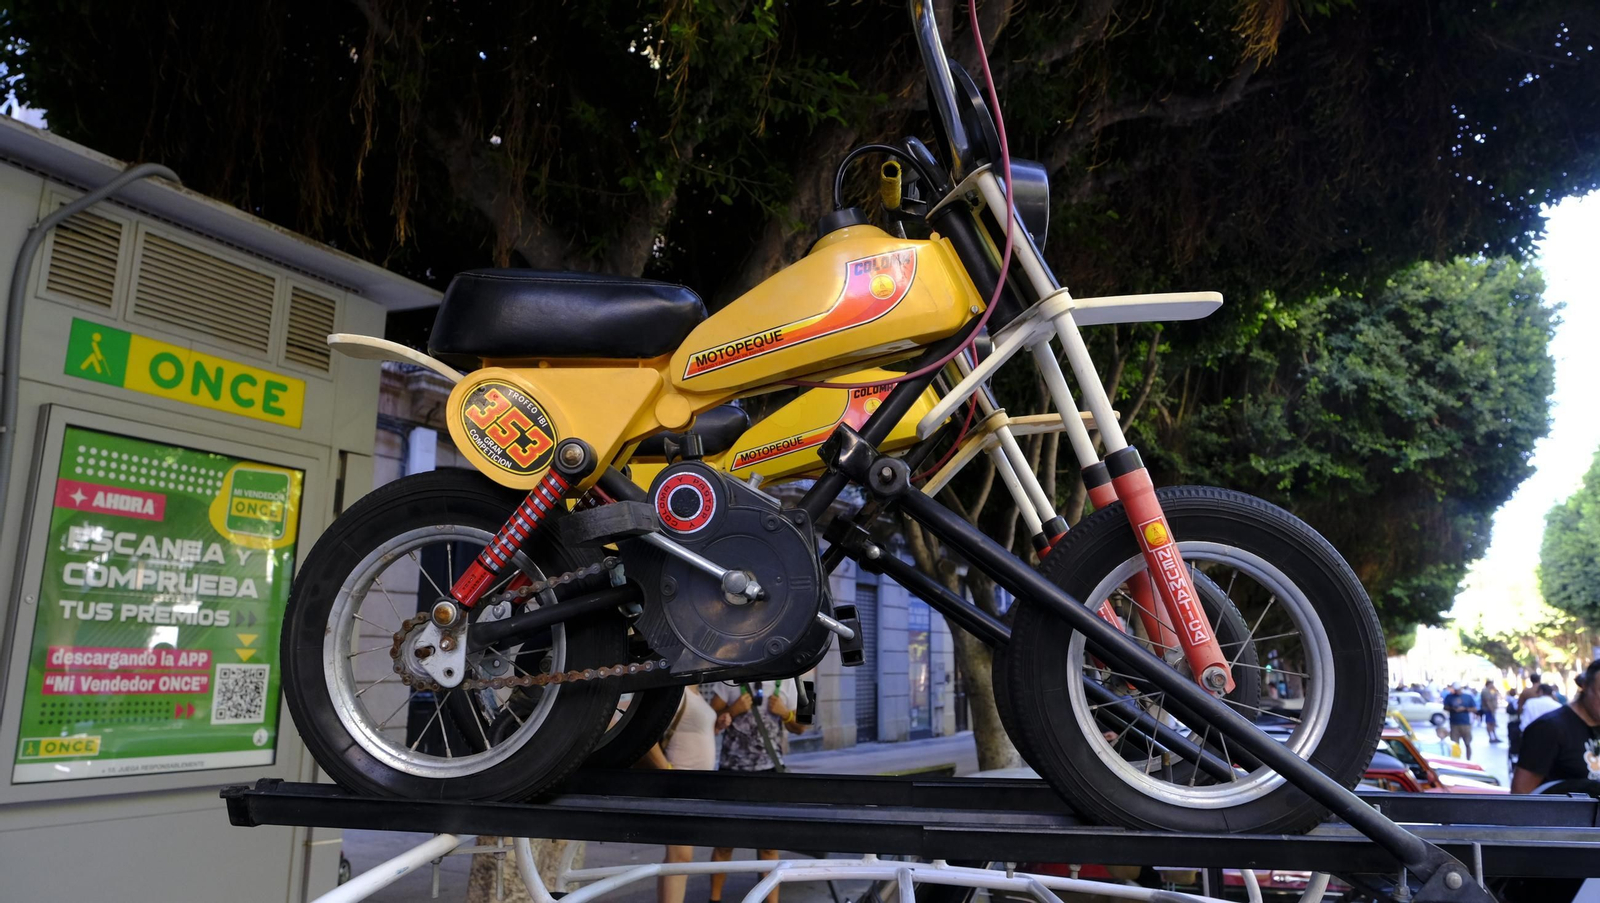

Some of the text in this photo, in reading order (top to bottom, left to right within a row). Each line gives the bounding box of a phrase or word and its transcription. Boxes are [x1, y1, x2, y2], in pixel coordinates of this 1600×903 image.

[695, 330, 784, 367] MOTOPEQUE
[149, 352, 288, 417] ONCE
[507, 389, 548, 428] TROFEO IBI
[465, 388, 554, 468] 353
[469, 429, 513, 468] COMPETICION
[483, 437, 503, 455] GRAN
[740, 436, 804, 462] MOTOPEQUE
[92, 491, 155, 515] AHORA
[234, 488, 285, 501] MI VENDEDOR
[235, 501, 278, 518] ONCE
[660, 485, 678, 527] COLOMA
[692, 479, 712, 519] PASTOR
[67, 526, 251, 566] ESCANEA Y
[62, 562, 259, 599] COMPRUEBA
[1157, 549, 1208, 642] NEUMATICA
[59, 600, 231, 627] TUS PREMIOS
[52, 649, 208, 670] descargando la APP
[80, 675, 156, 692] Vendedor
[44, 740, 94, 754] ONCE
